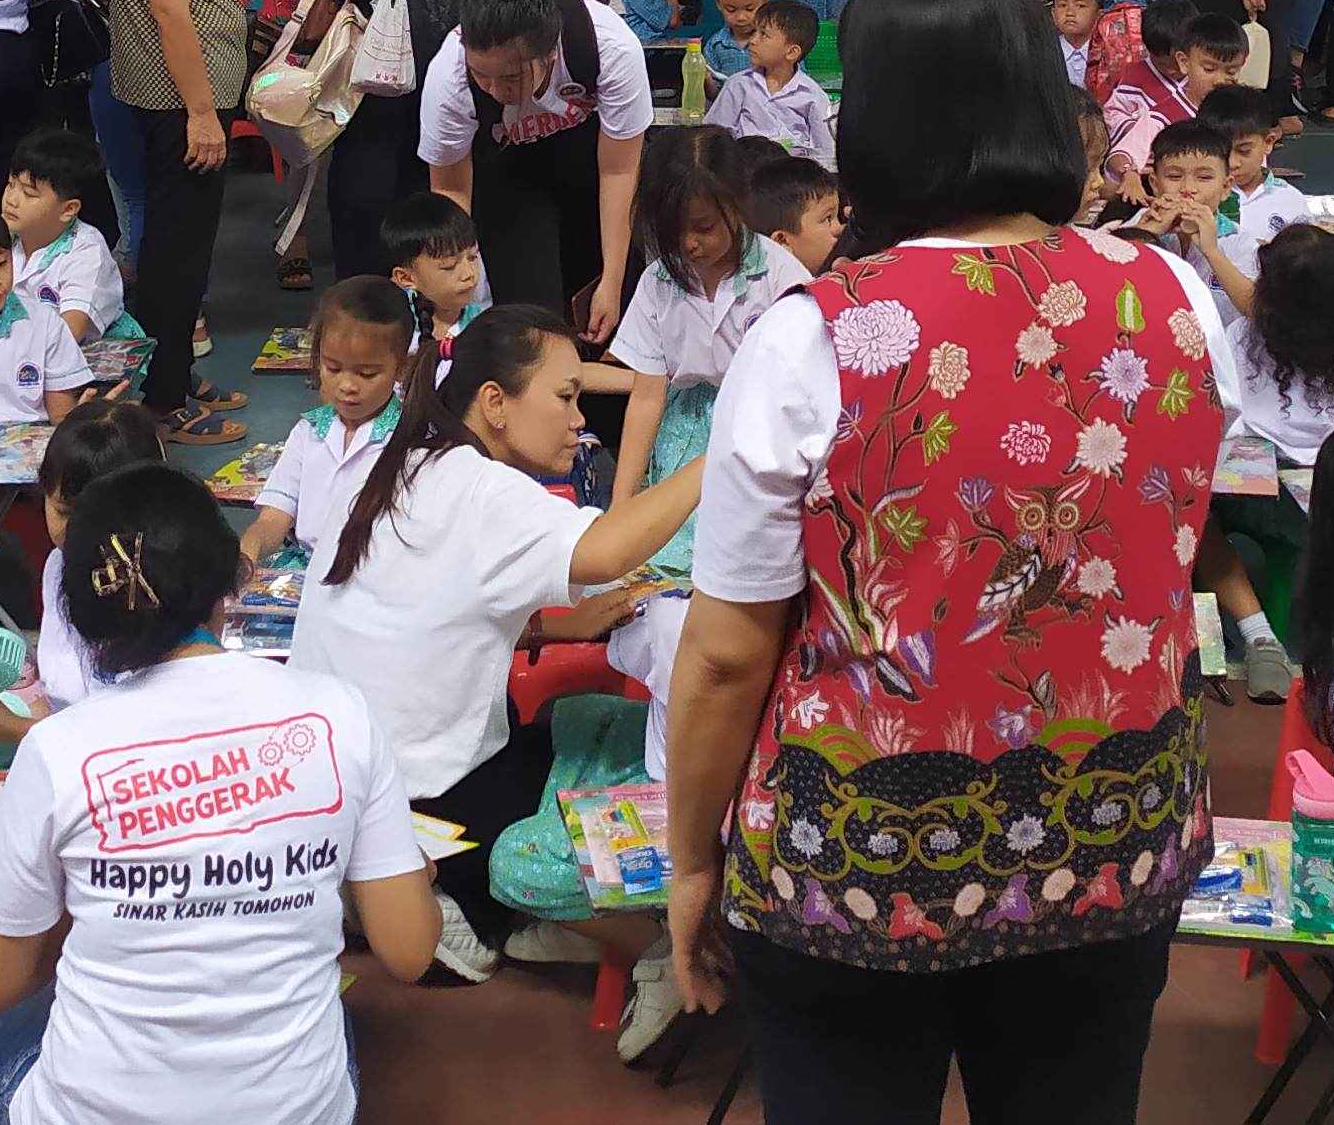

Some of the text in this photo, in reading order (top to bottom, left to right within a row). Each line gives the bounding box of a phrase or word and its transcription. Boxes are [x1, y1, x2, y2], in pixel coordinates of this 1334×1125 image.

[113, 747, 250, 804] SEKOLAH
[118, 767, 296, 839] PENGGERAK
[90, 838, 338, 899] Happy Holy Kids
[113, 890, 315, 921] SINAR KASIH TOMOHON
